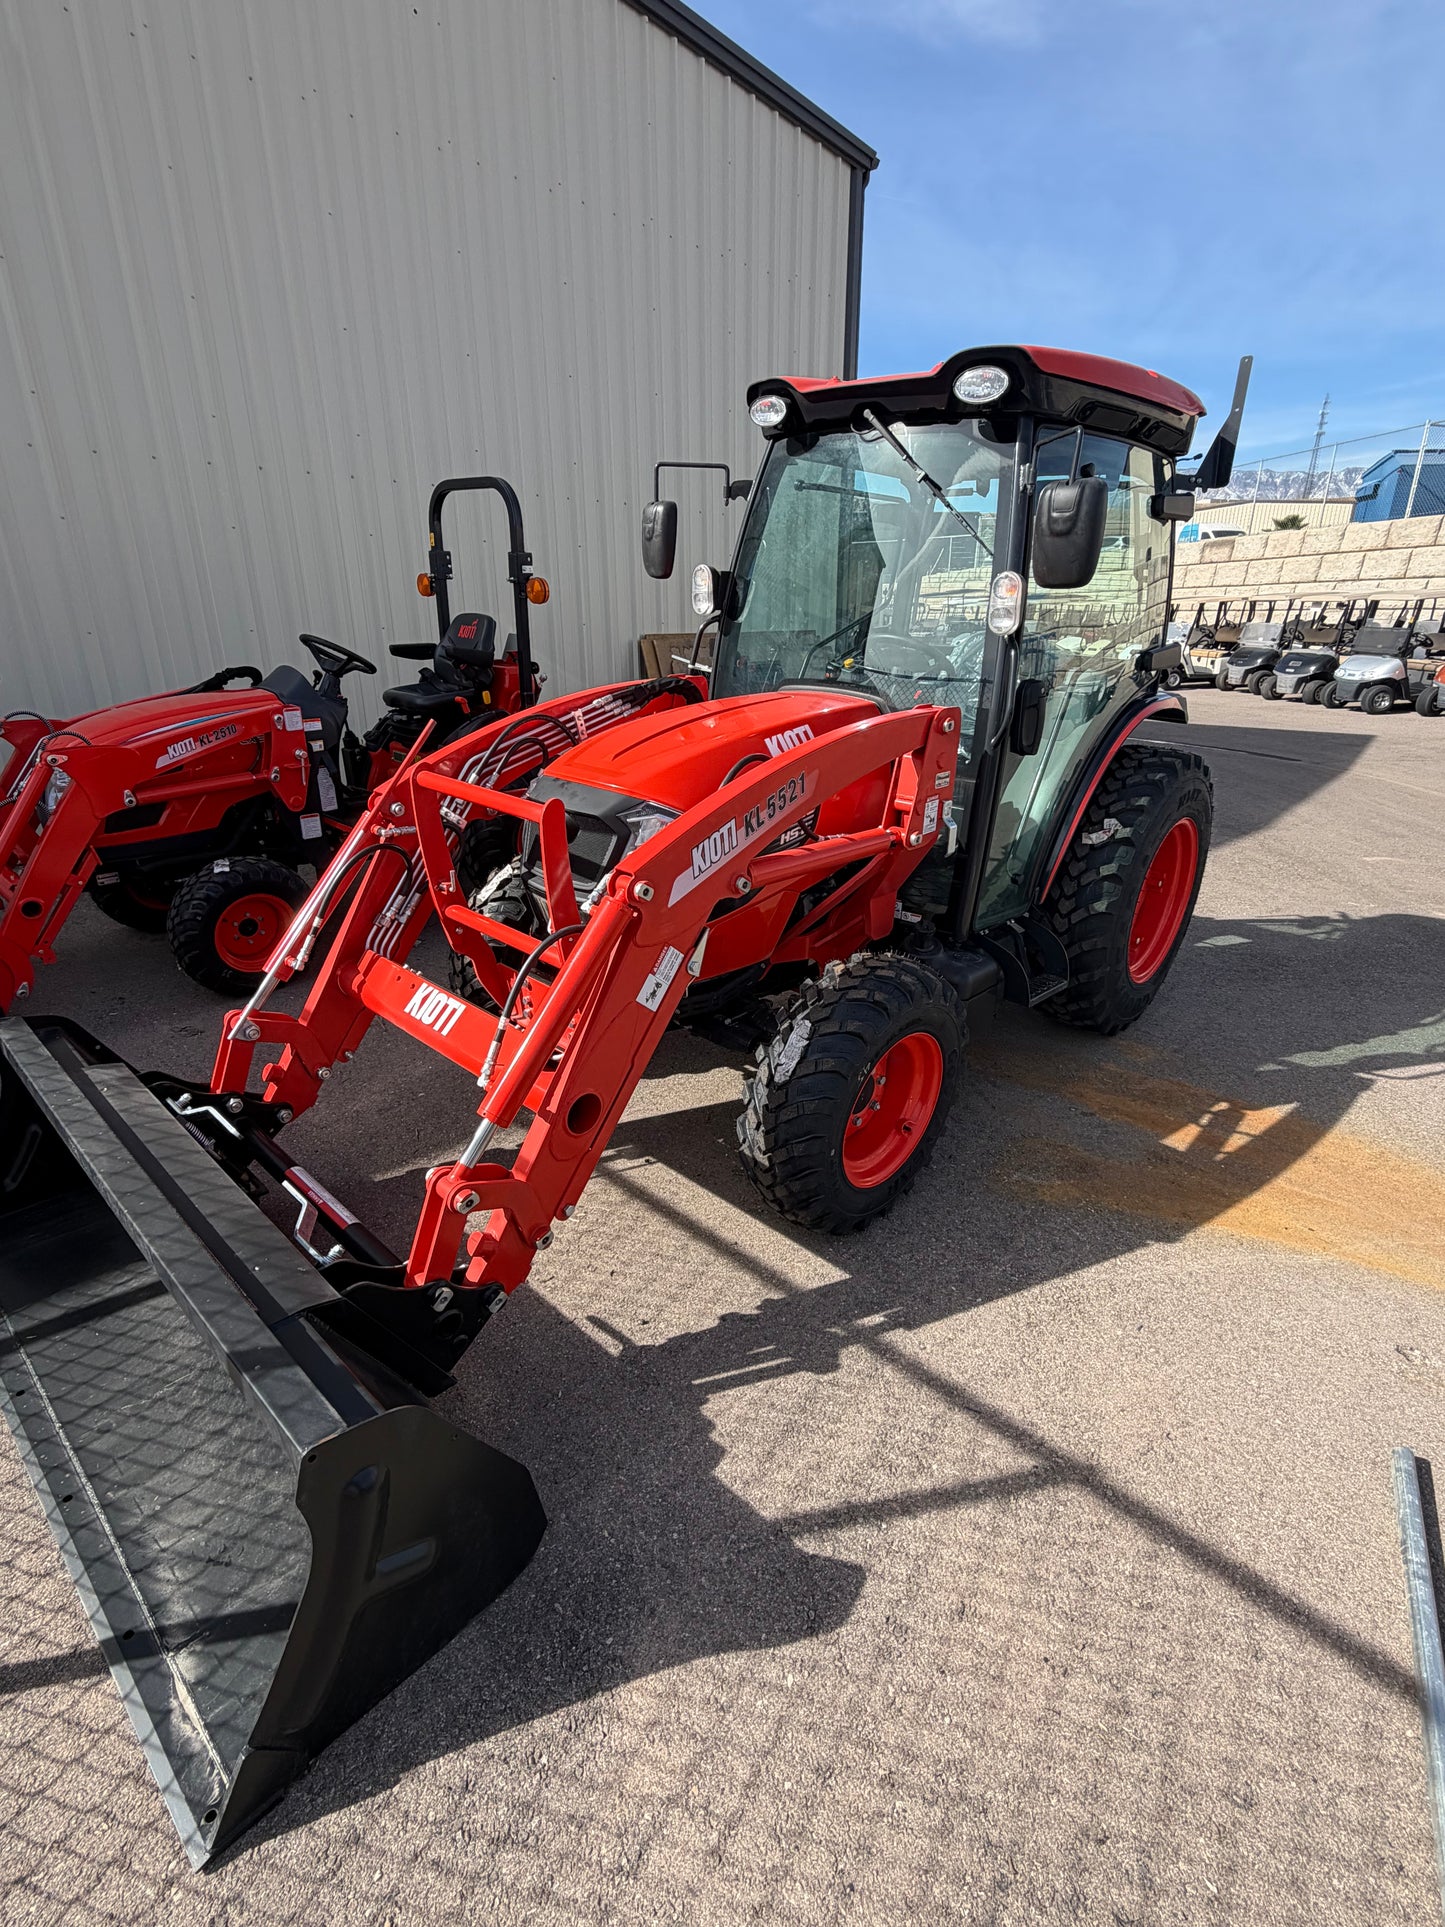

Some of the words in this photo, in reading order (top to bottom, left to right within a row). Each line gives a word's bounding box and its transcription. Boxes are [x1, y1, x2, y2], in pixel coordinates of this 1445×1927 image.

[167, 737, 196, 760] KIOTI
[764, 724, 815, 758] KIOTI
[690, 816, 739, 879] KIOTI
[403, 982, 467, 1037] KIOTI
